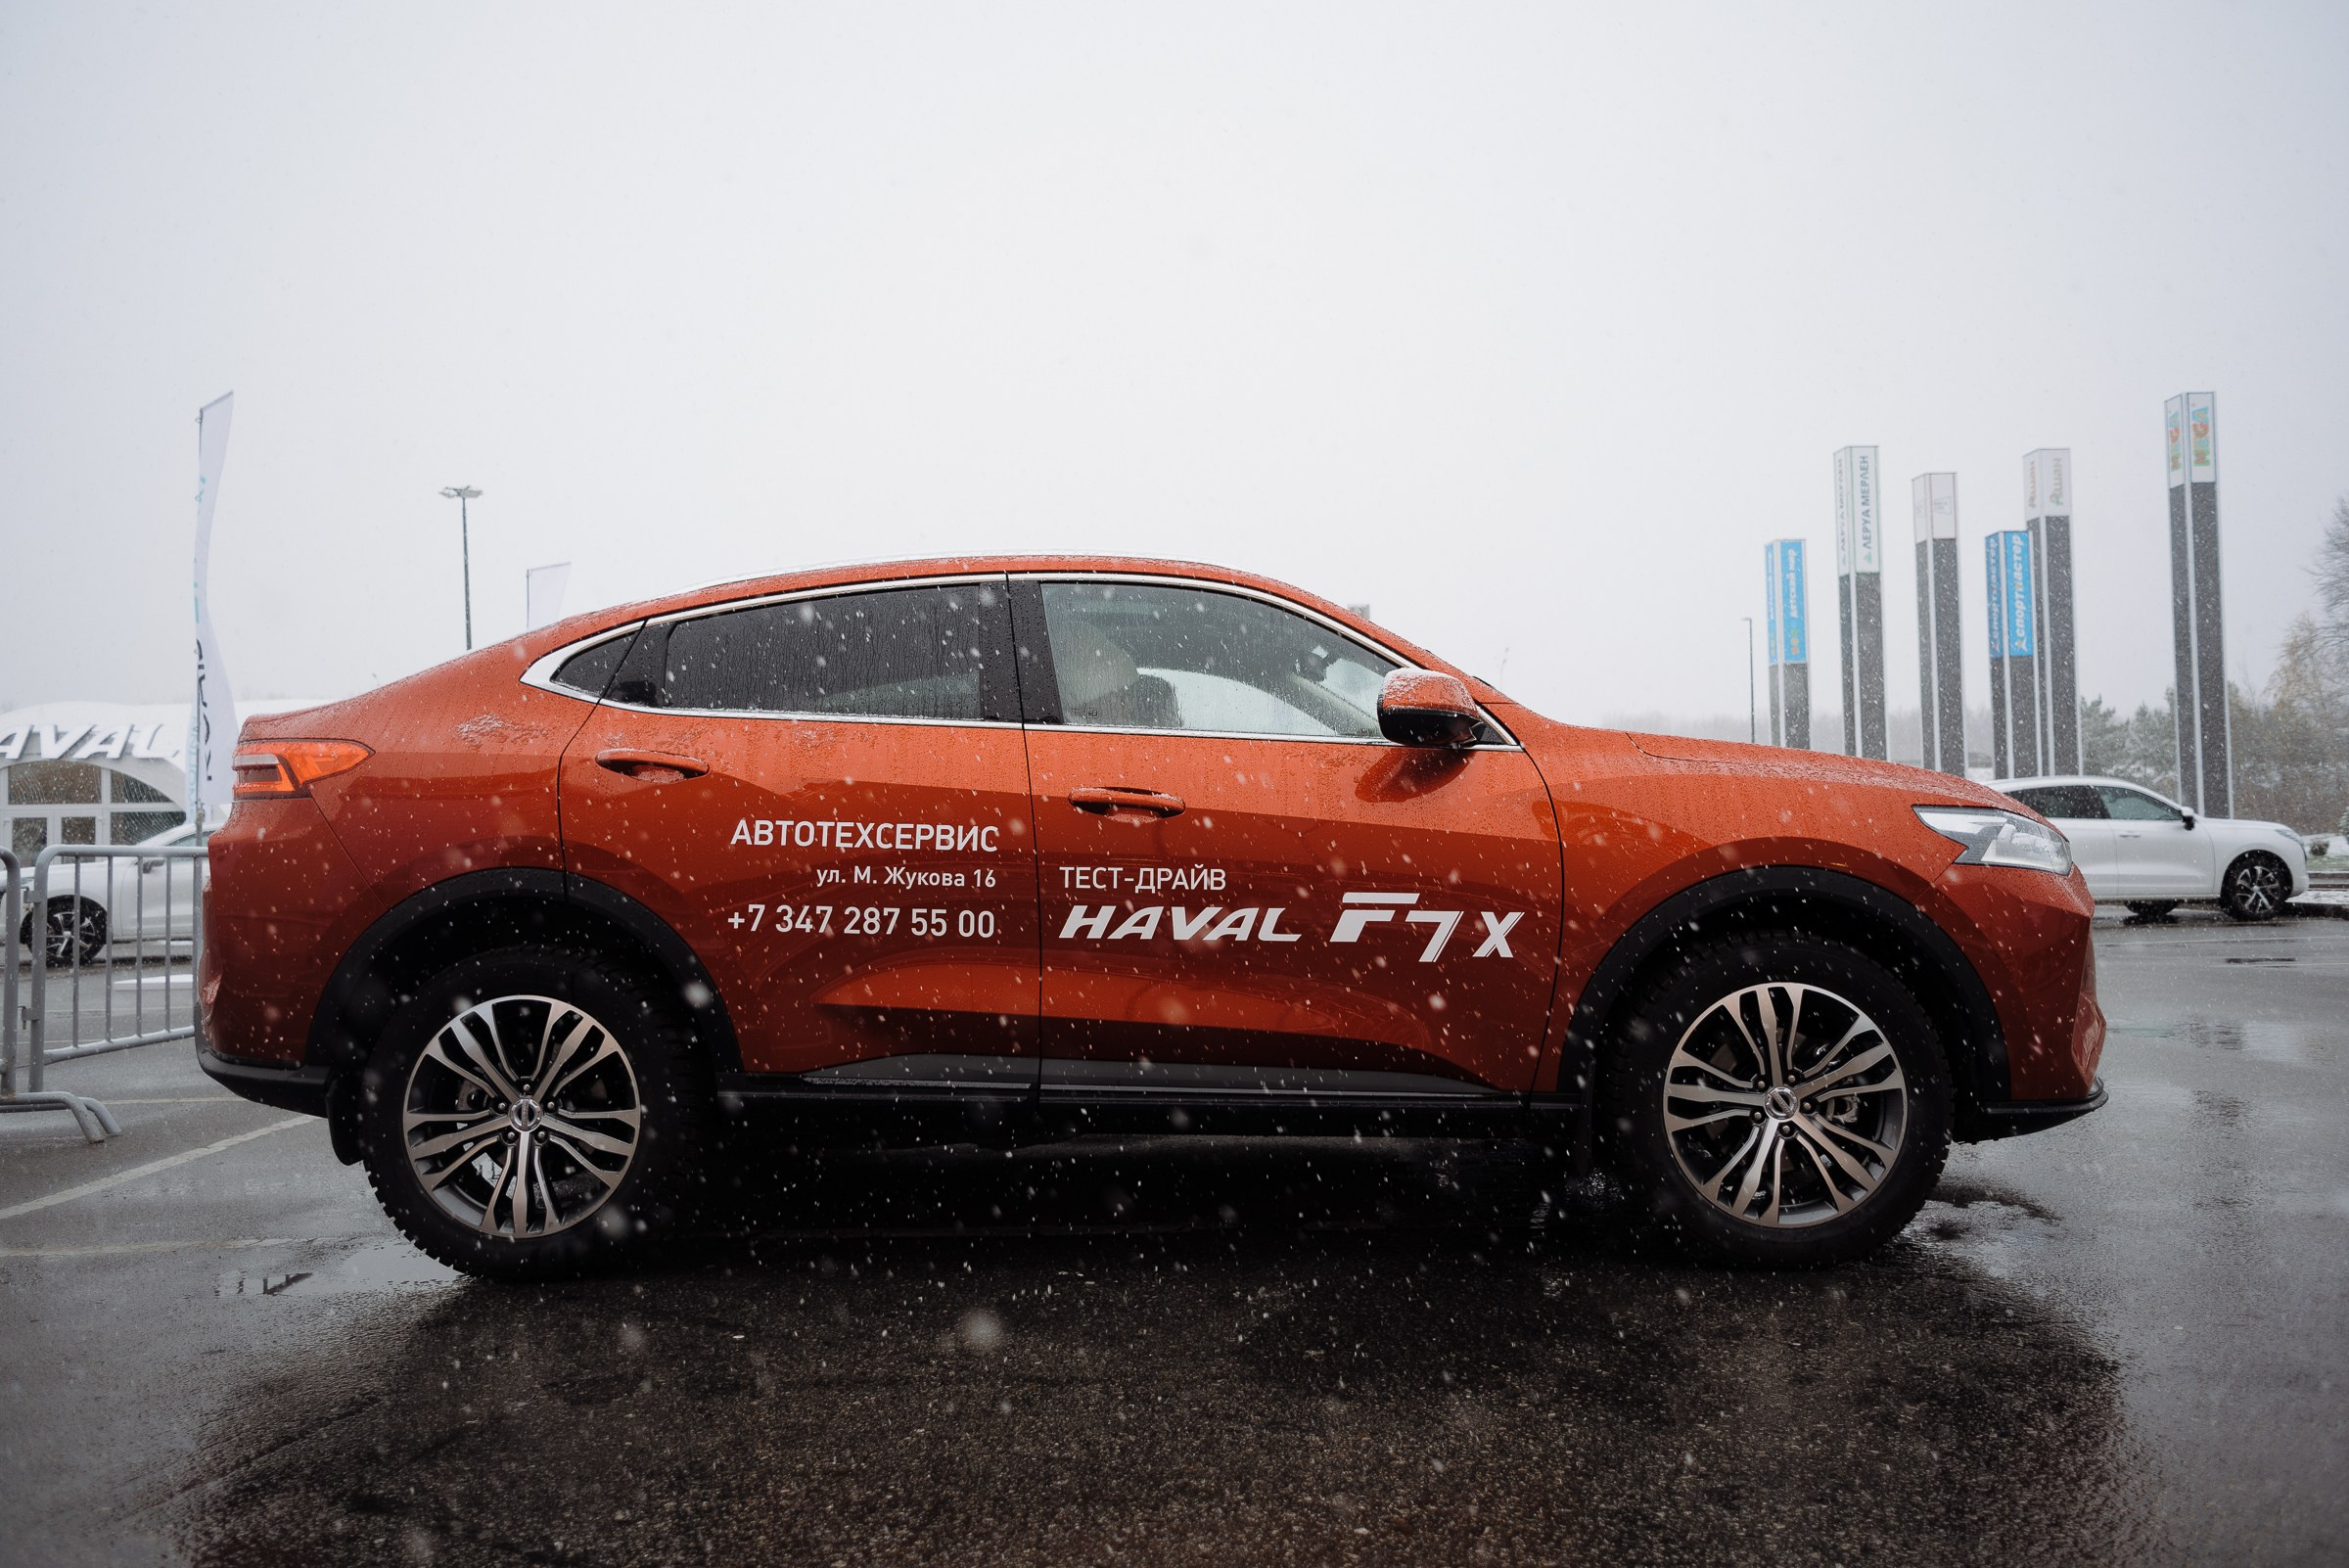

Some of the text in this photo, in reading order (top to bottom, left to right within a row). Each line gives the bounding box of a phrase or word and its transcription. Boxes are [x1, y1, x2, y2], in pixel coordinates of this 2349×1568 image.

[1860, 455, 1871, 550] ЛЕРУА МЕРЛЕН
[730, 819, 998, 852] АВТОТЕХСЕРВИС
[816, 866, 996, 888] ул. М. Жукова 16
[1059, 863, 1226, 894] ТЕСТ-ДРАЙВ
[727, 904, 995, 938] +7 347 287 55 00
[1059, 905, 1303, 942] HAVAL
